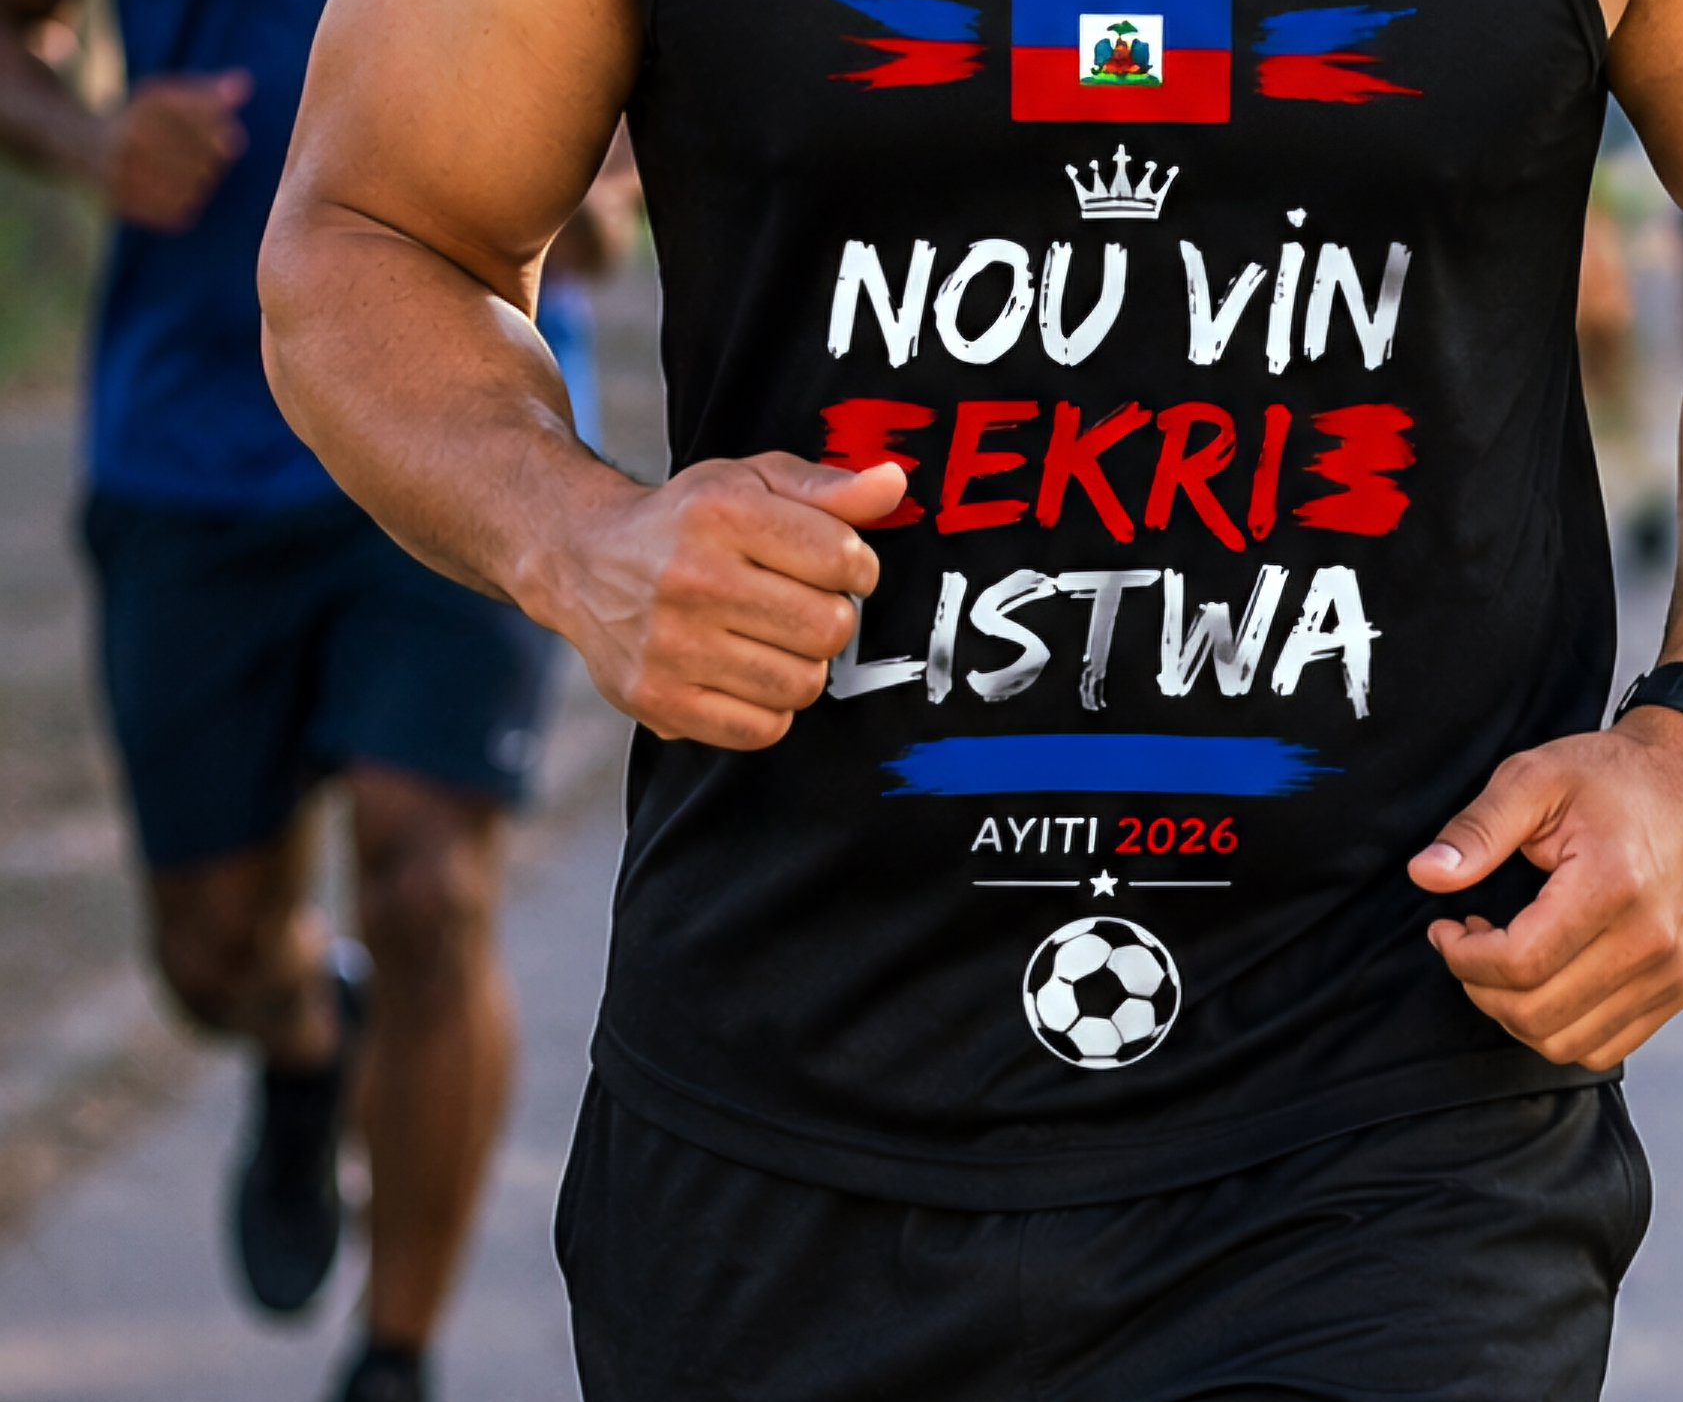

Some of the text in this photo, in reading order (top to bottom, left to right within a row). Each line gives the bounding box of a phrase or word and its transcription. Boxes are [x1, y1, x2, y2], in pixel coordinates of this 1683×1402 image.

[828, 240, 1128, 368] NOU
[935, 401, 1292, 552] EKRI
[828, 565, 1383, 720] LISTWA
[970, 816, 1240, 856] AYITI 2026
